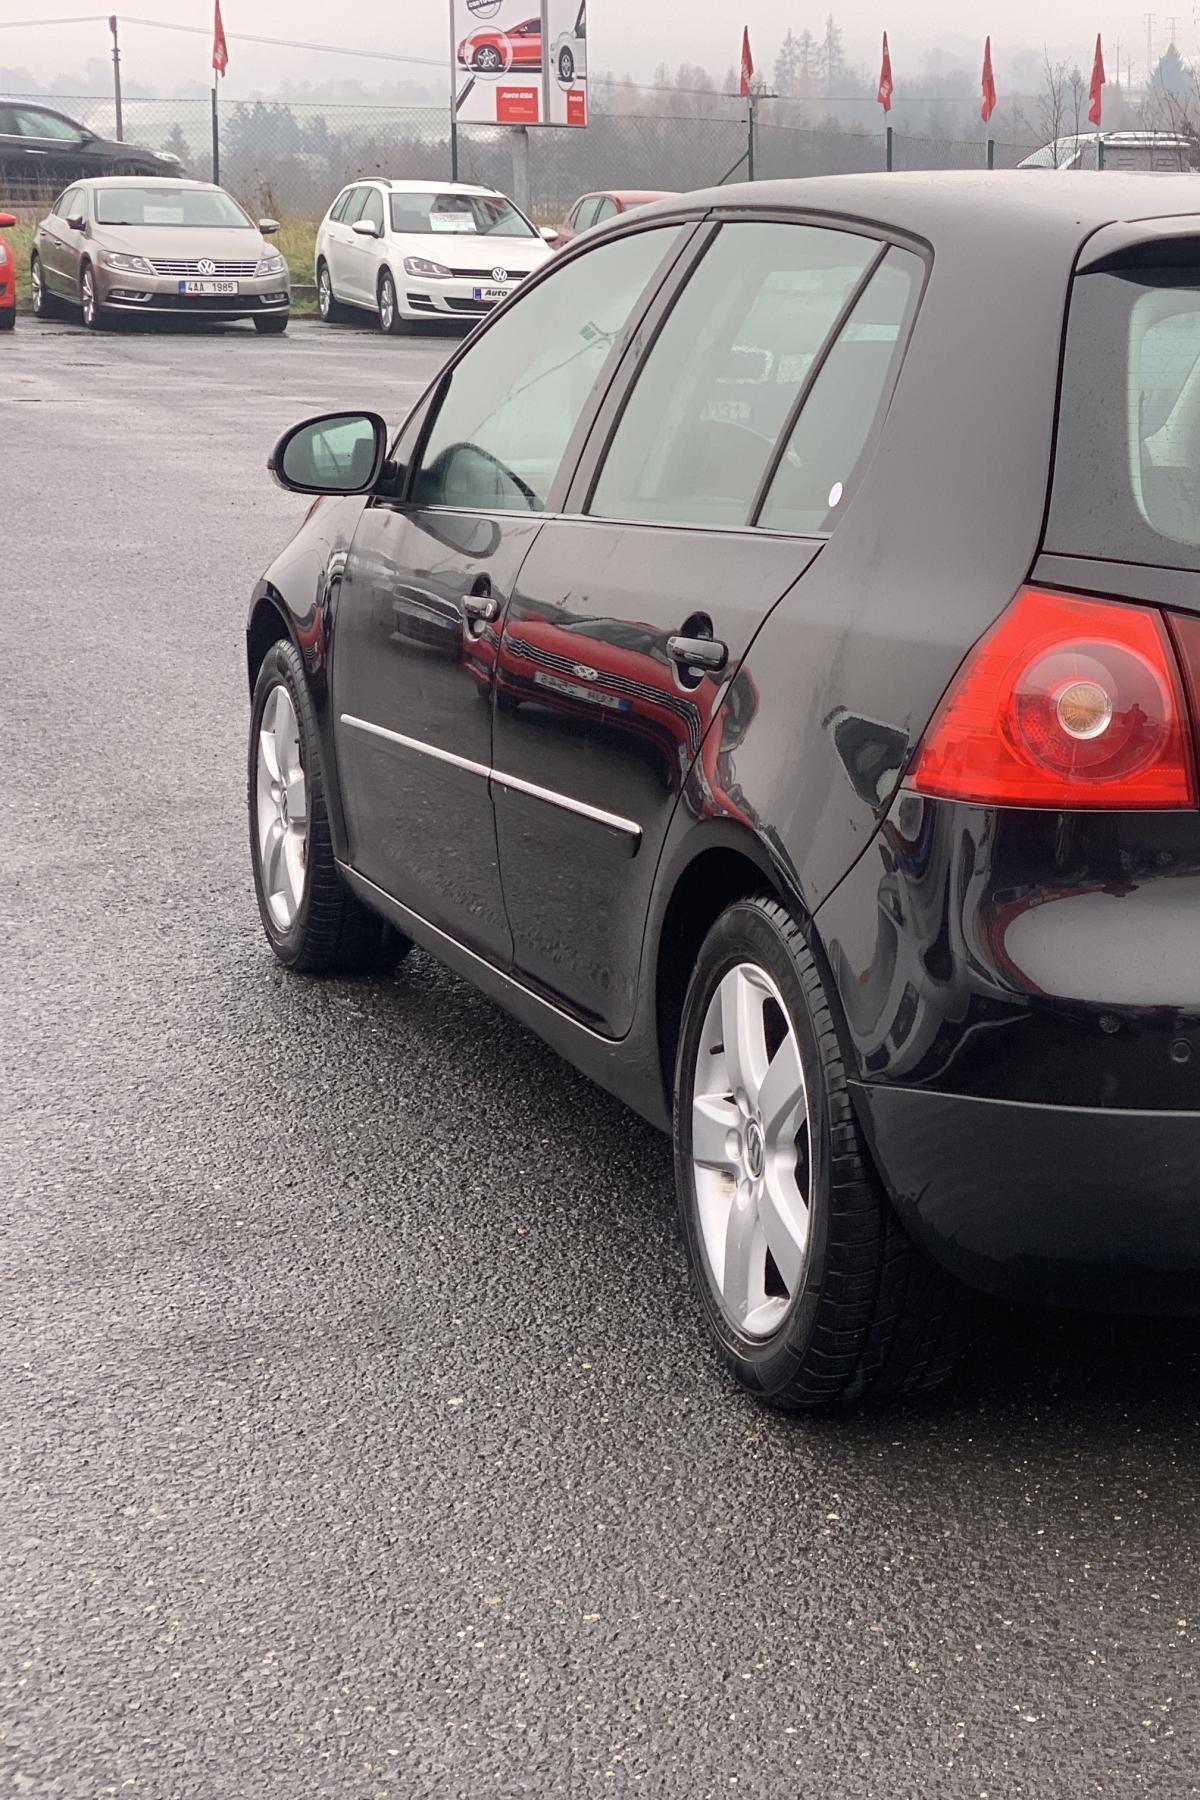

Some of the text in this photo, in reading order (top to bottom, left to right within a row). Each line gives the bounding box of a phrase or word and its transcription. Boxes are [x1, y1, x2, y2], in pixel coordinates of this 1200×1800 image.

[187, 283, 233, 292] 4AA 1985
[485, 289, 508, 297] Auto
